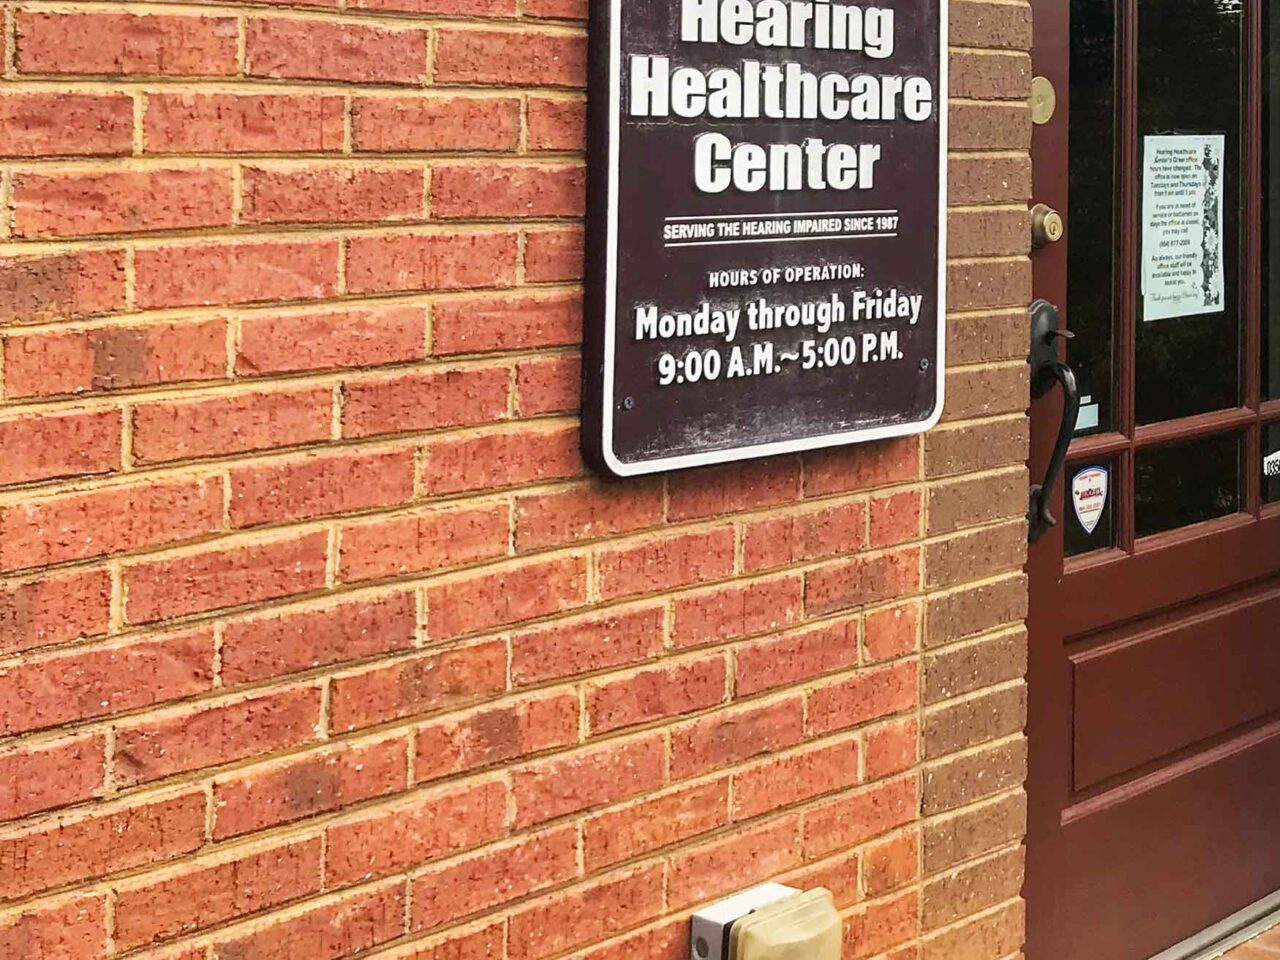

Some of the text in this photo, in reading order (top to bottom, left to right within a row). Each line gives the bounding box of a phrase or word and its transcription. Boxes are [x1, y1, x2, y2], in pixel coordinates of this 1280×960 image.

[630, 54, 933, 122] Healthcare
[694, 132, 881, 194] Center
[663, 216, 899, 240] SERVING THE HEARING IMPAIRED SINCE 1987
[708, 262, 865, 288] HOURS OF OPERATION:
[634, 288, 923, 342] Monday through Friday
[657, 348, 722, 386] 9:00
[861, 330, 904, 364] P.M.
